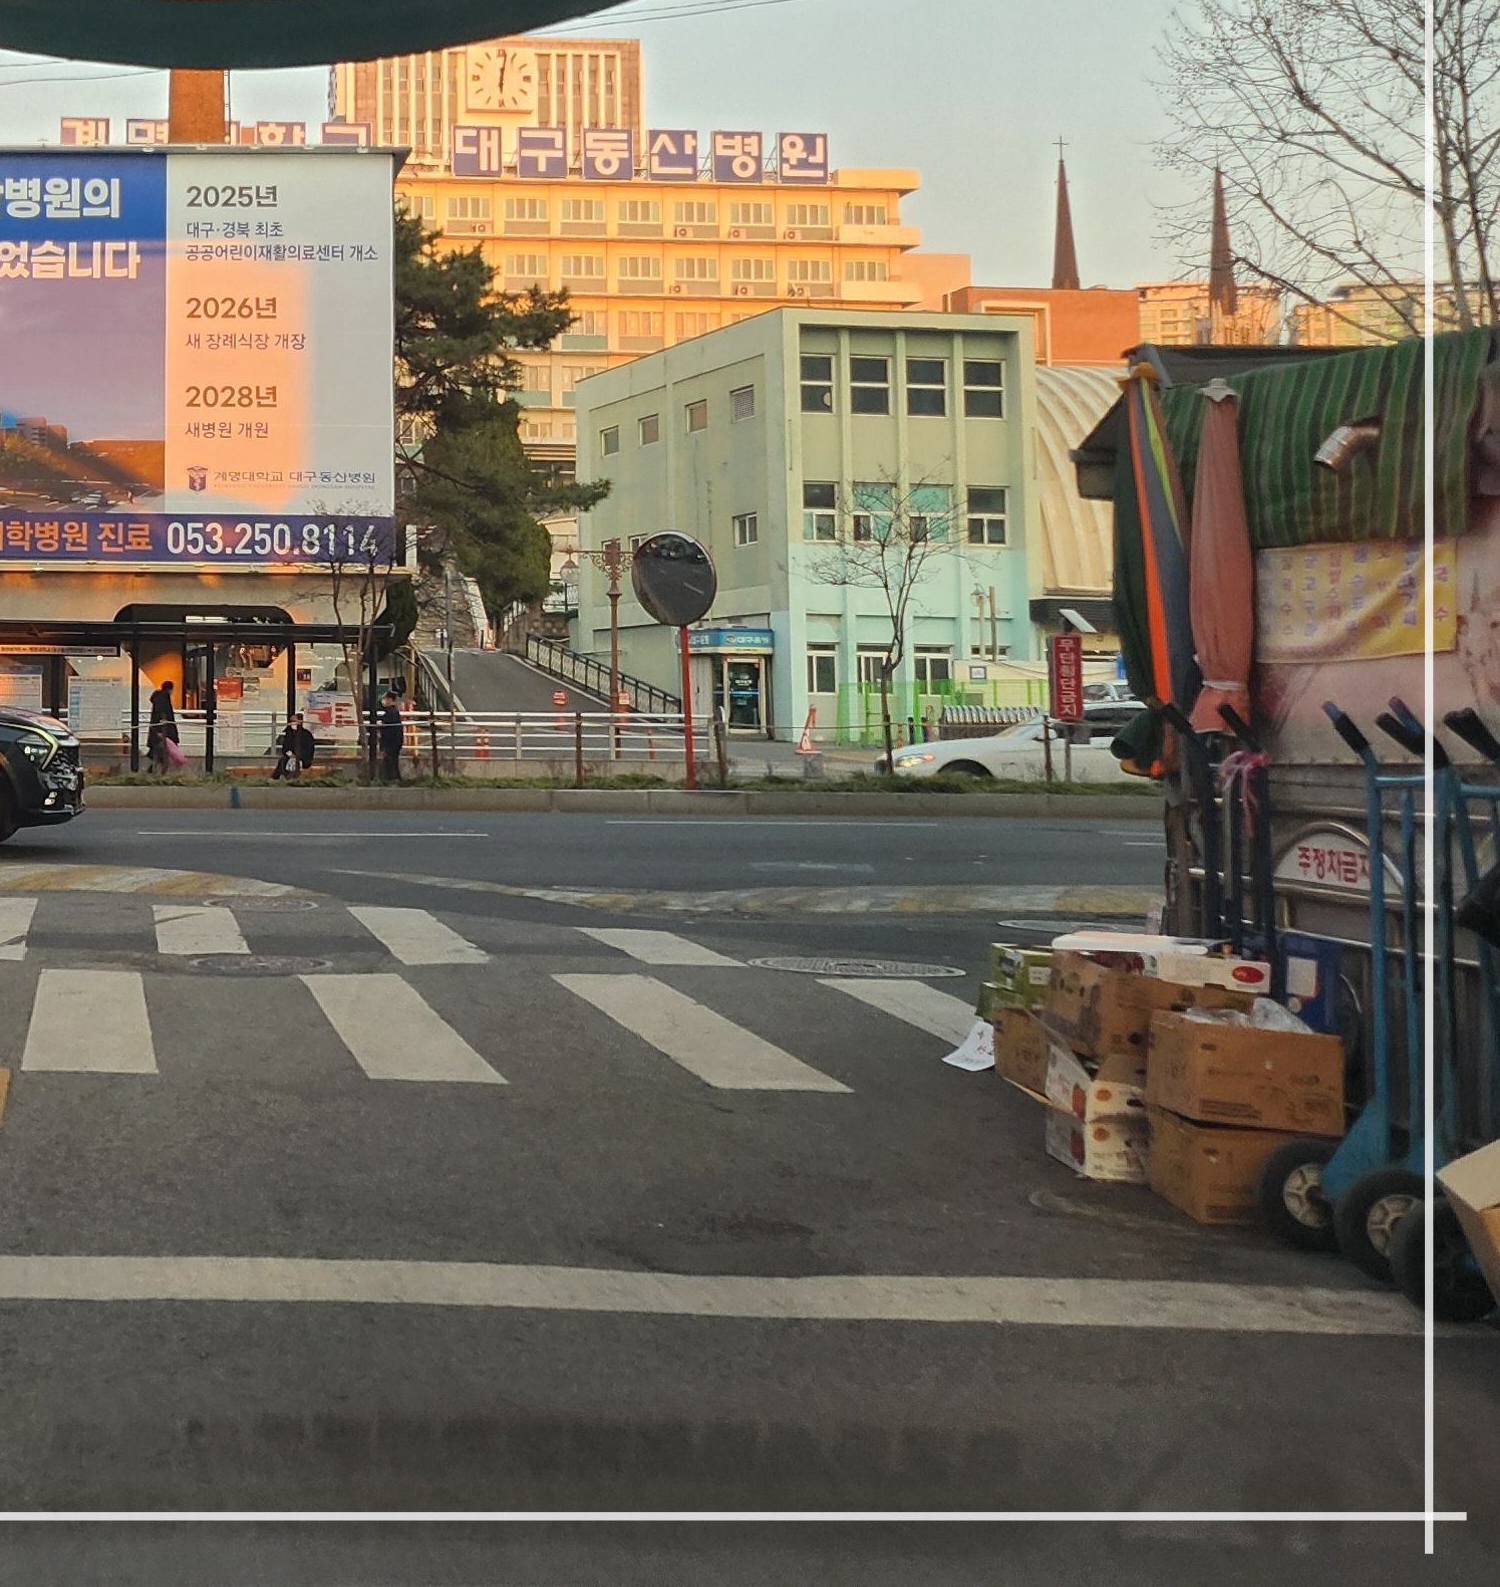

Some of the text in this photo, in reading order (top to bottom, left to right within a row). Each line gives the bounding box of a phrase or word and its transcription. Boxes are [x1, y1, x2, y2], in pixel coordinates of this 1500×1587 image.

[455, 128, 828, 178] 대구동산병원
[186, 185, 278, 208] 2025년
[186, 221, 284, 239] 대구·경북 최초
[185, 244, 379, 261] 공공어린이재활의료센터 개소
[185, 296, 278, 319] 2026년
[185, 333, 306, 351] 새 장례식장 개장
[185, 385, 278, 408] 2028년
[185, 422, 269, 439] 새병원 개원
[214, 471, 376, 484] 계명대학교 대구동산병원
[97, 521, 154, 553] 진료
[166, 522, 378, 556] 053.250.8114
